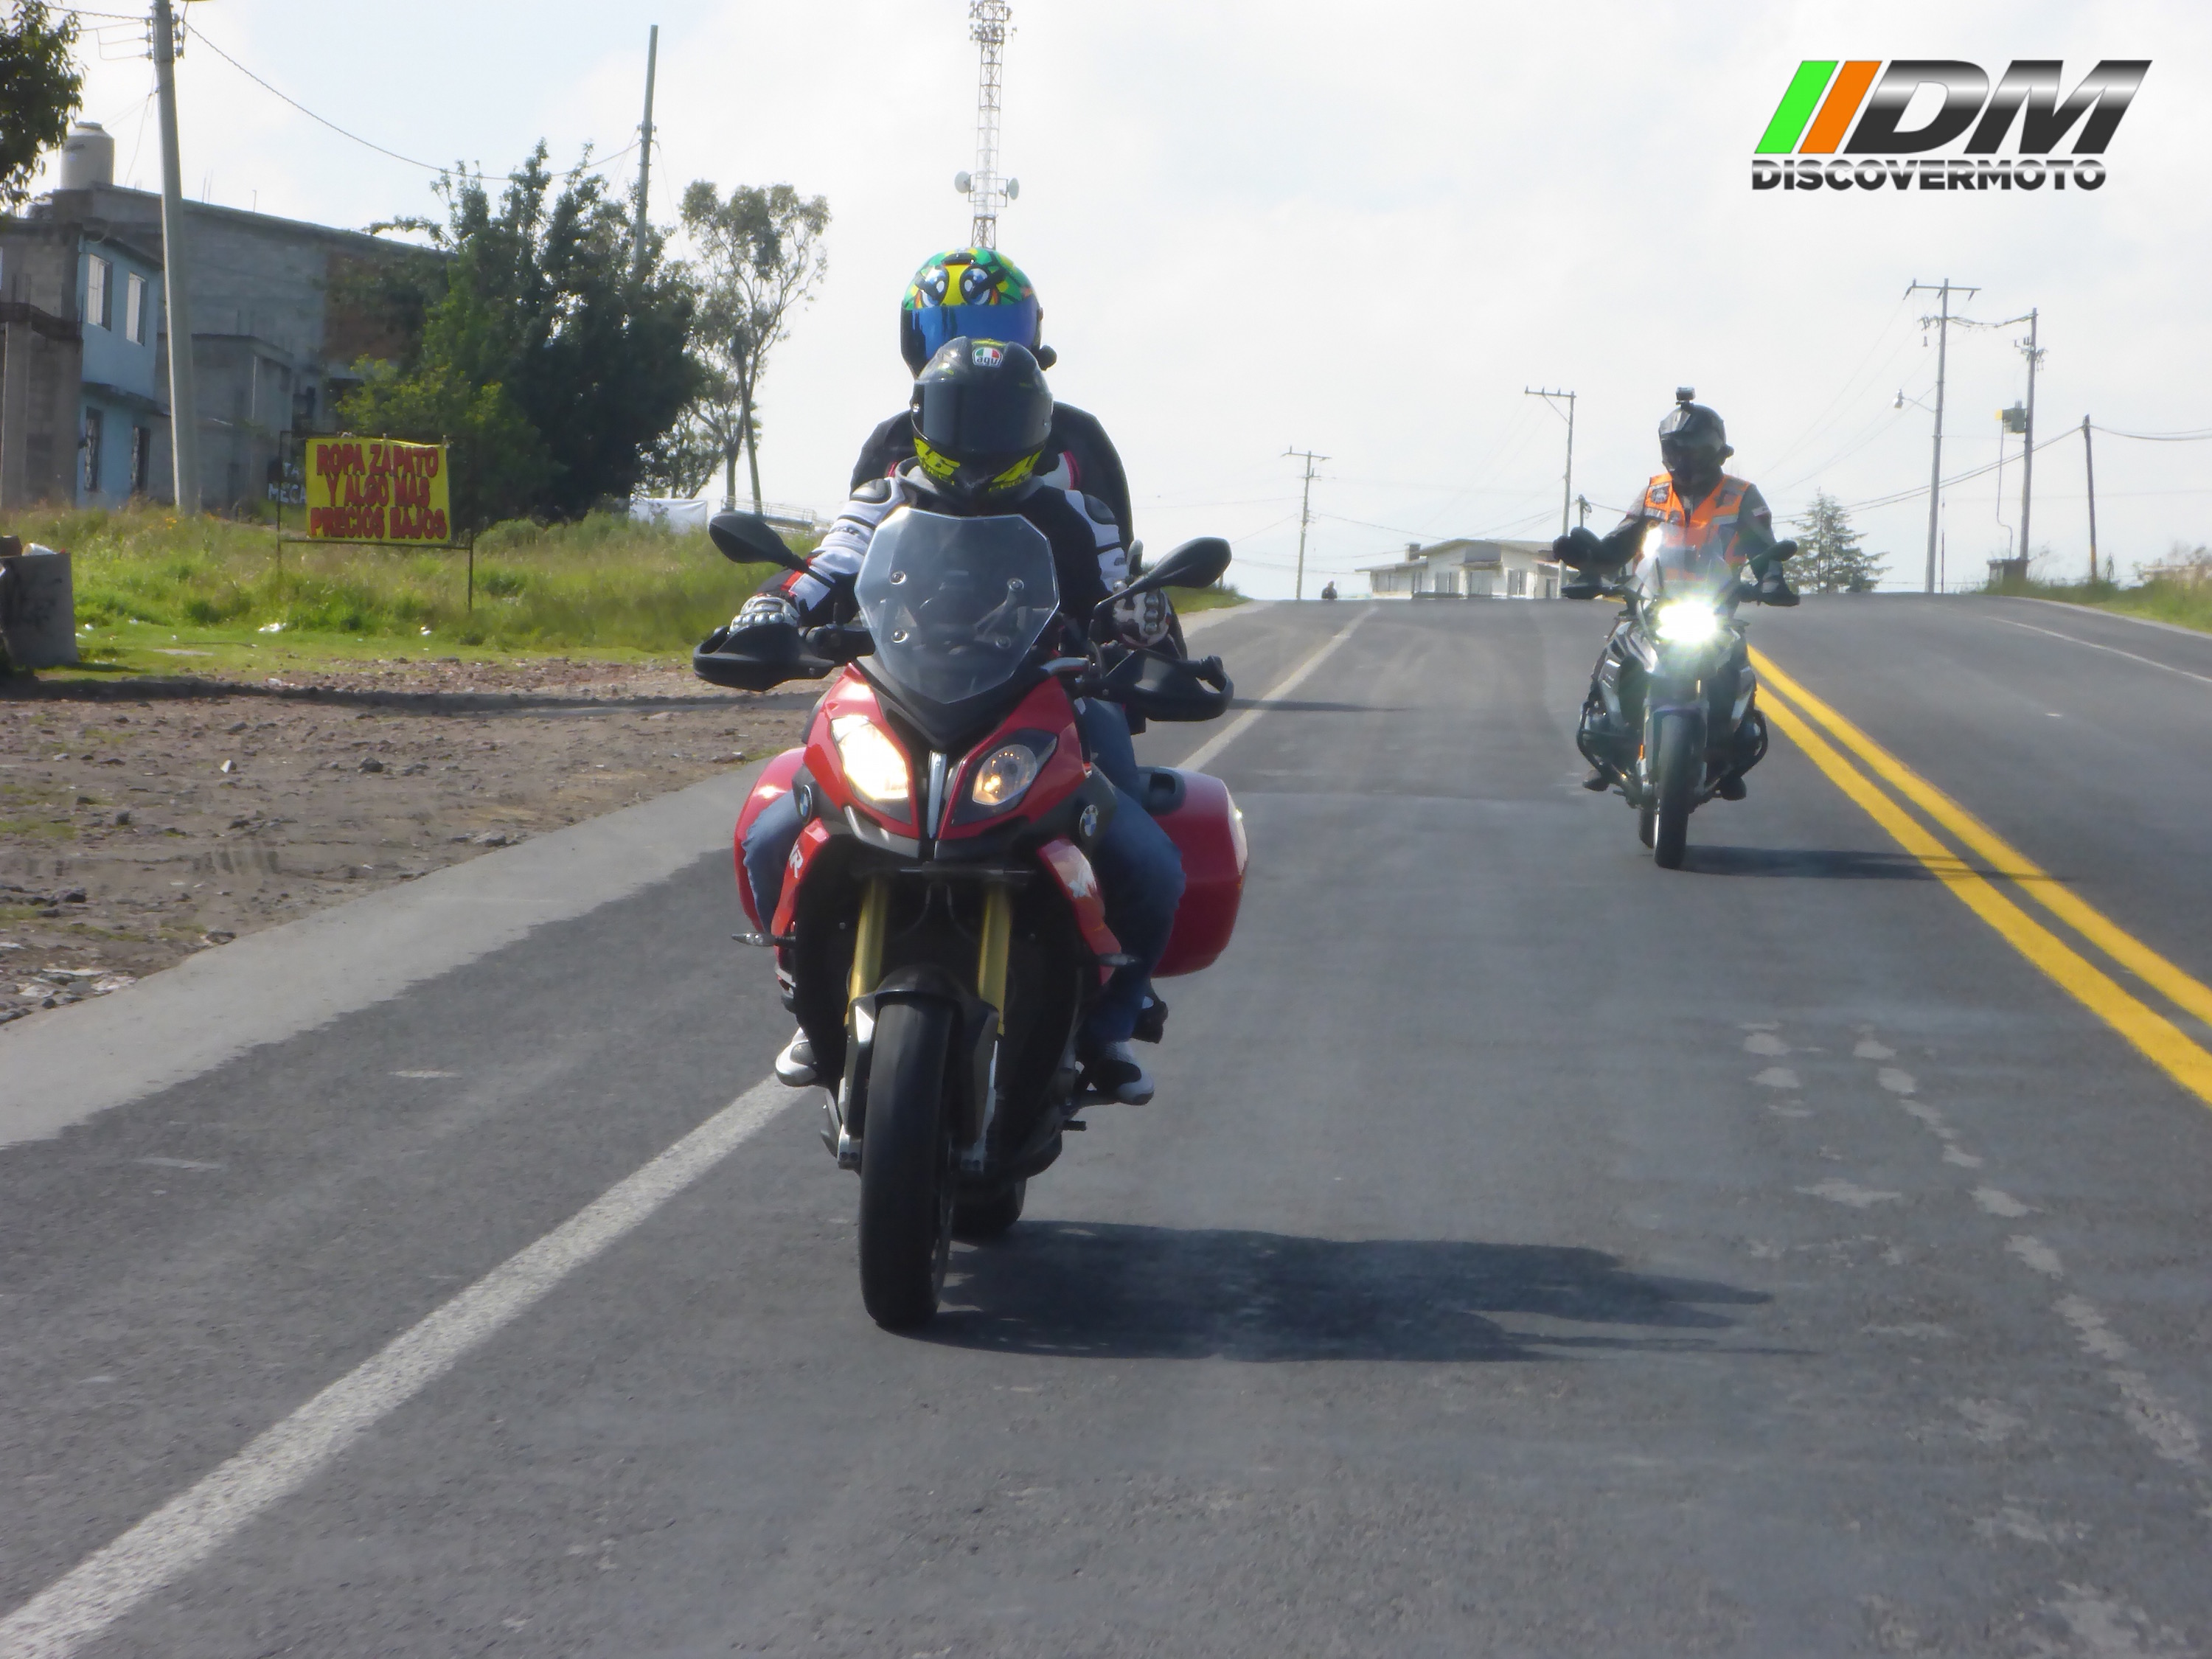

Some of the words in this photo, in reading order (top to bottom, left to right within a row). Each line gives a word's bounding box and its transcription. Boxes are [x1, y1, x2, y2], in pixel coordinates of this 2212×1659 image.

[316, 444, 365, 476] ROPA
[369, 444, 438, 477] ZAPATO
[325, 474, 341, 507] Y
[344, 474, 389, 507] ALGO
[394, 476, 430, 508] MAS
[310, 507, 385, 538] PRECIOS
[389, 507, 447, 539] BAJOS
